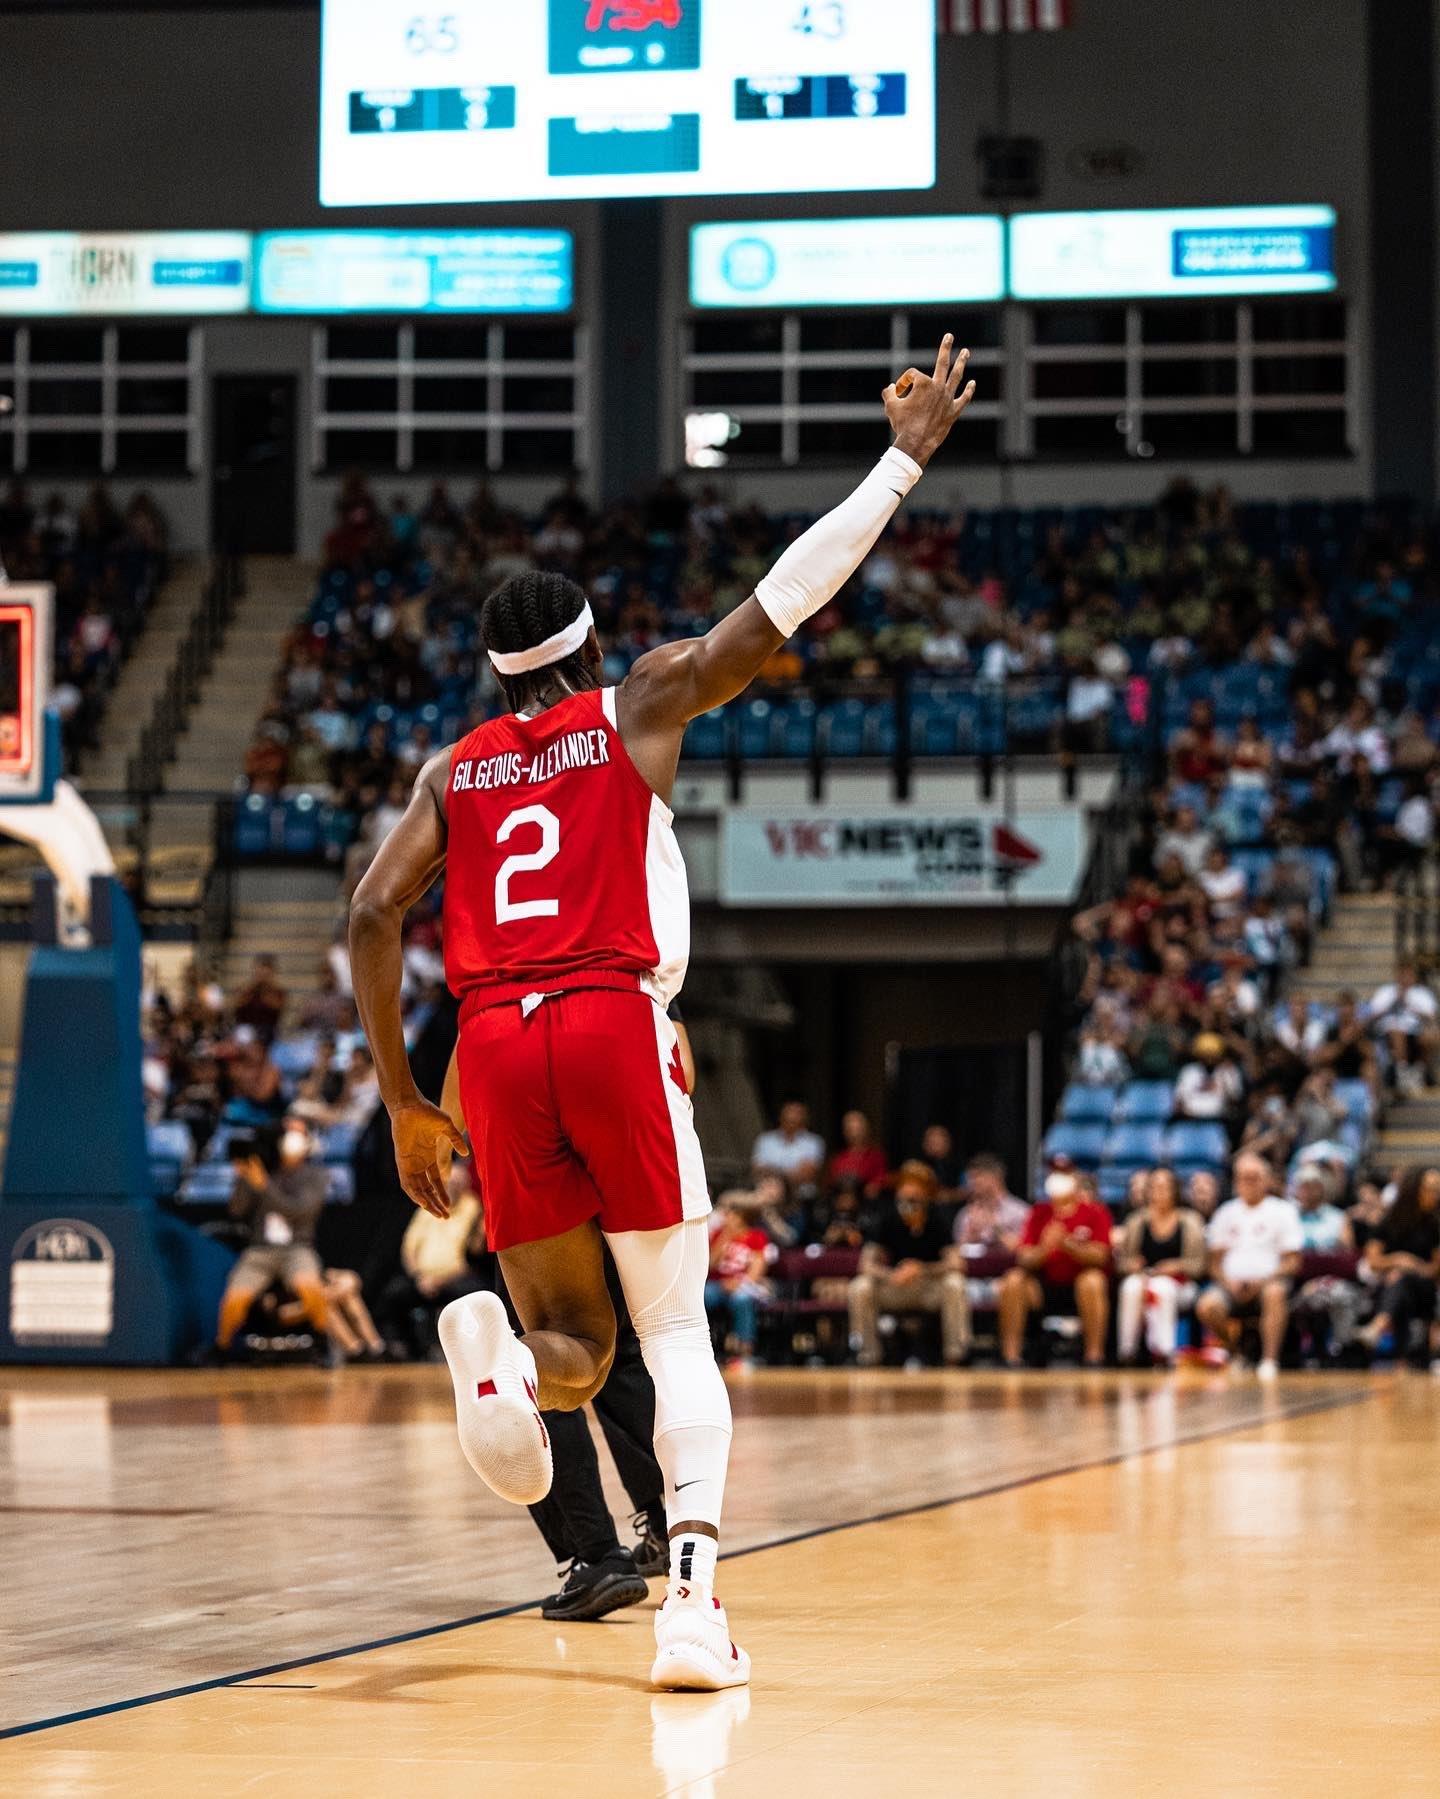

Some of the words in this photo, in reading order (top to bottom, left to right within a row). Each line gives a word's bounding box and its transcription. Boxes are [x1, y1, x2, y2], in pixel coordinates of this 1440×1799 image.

[403, 14, 460, 56] 65
[453, 729, 609, 792] GILGEOUS-ALEXANDER
[495, 804, 560, 926] 2
